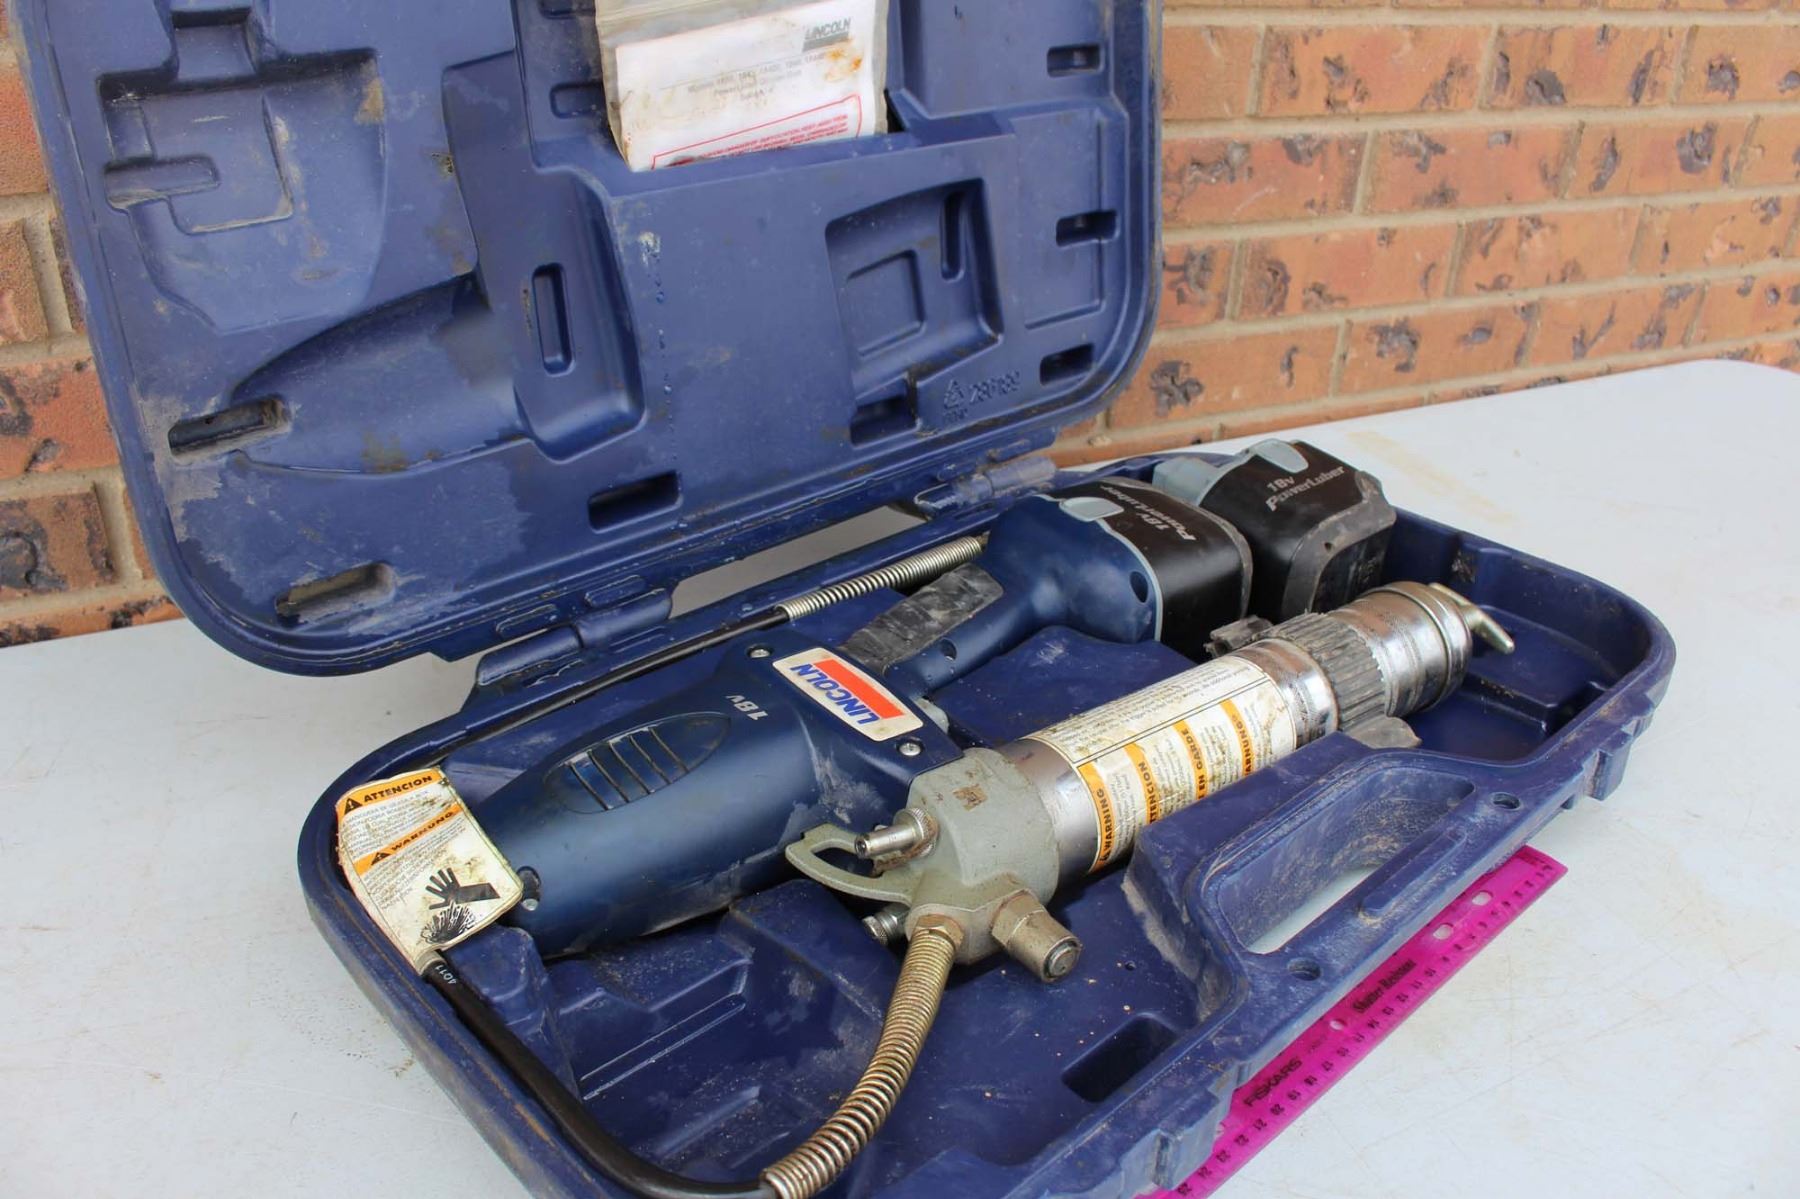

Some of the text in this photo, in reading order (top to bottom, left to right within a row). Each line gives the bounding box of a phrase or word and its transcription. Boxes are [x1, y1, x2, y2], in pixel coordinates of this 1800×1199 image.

[804, 17, 852, 41] LINCOLN
[1265, 465, 1346, 512] PowerLuber
[788, 662, 881, 726] LINCOLN
[1180, 728, 1204, 770] GARDE
[1235, 717, 1254, 777] ARNUNG
[363, 775, 434, 803] ATTENCION
[391, 811, 455, 851] WARNUNG
[1096, 789, 1113, 852] WARNING
[1243, 1056, 1303, 1107] FISKARS
